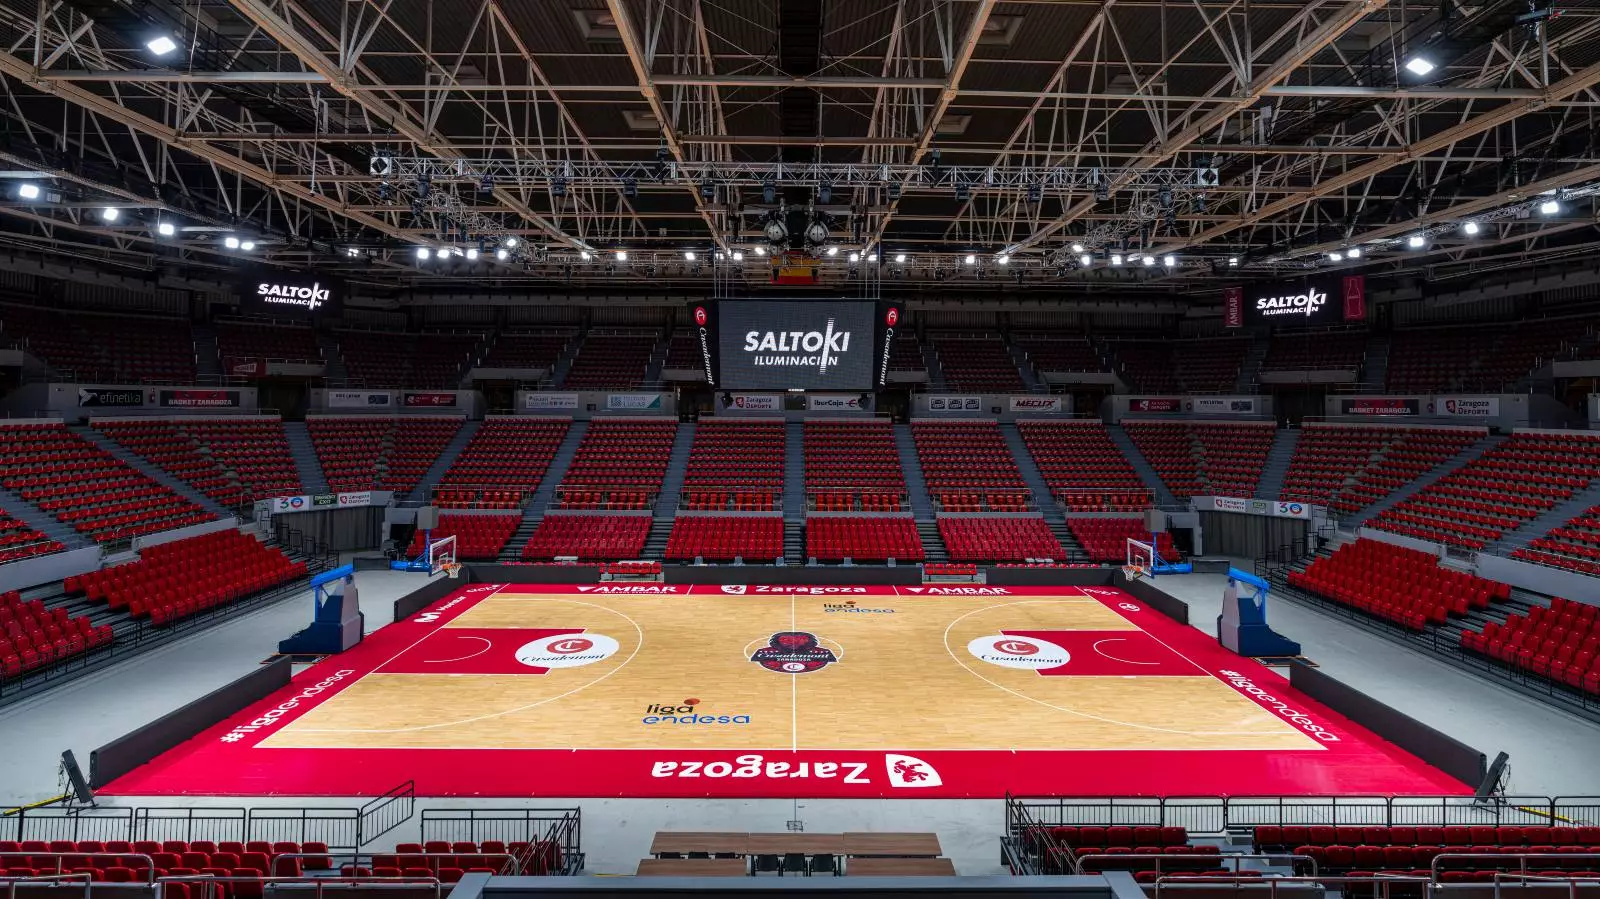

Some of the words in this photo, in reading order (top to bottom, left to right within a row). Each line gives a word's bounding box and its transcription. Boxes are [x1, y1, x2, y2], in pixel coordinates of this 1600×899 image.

[257, 282, 330, 302] SALTOKI
[264, 296, 322, 308] ILUMINACIN
[1256, 287, 1328, 309] SALTOKI
[1229, 295, 1239, 325] AMBAR
[1262, 305, 1319, 316] ILUMINACIN
[743, 317, 851, 353] SALTOKI
[699, 327, 715, 385] Casademont
[754, 355, 839, 367] ILUMINACIN
[880, 327, 894, 386] Casademont
[1458, 400, 1490, 408] Zaragoza
[755, 585, 867, 594] Zaragoza
[220, 669, 356, 743] #ligaendesa
[646, 703, 694, 716] liga
[1219, 669, 1342, 742] #ligaendesa
[642, 712, 751, 725] endesa
[651, 754, 871, 784] Zaragoza
